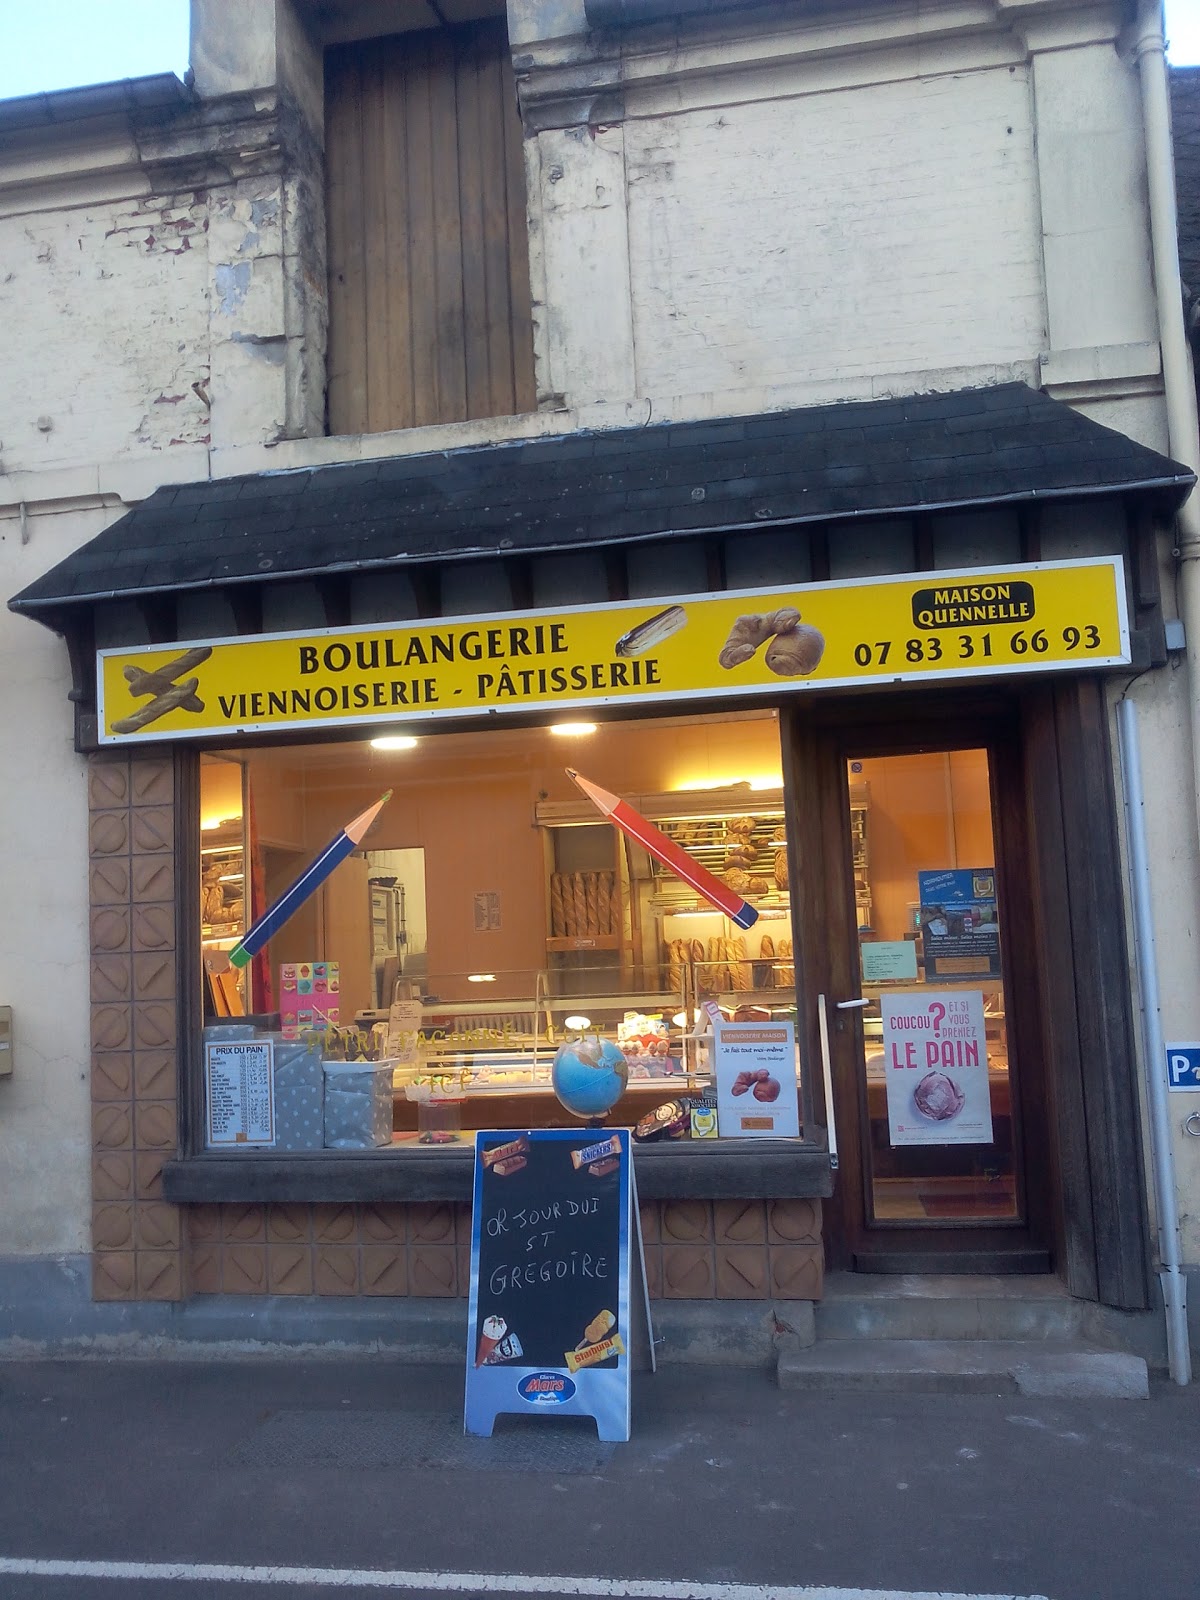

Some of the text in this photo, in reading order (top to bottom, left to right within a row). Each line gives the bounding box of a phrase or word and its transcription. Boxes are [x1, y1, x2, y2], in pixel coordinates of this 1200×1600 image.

[934, 585, 1012, 605] MAISON
[918, 602, 1031, 626] QUENNELLE
[299, 623, 569, 675] BOULANGERIE
[854, 624, 1101, 667] 07 83 31 66 93
[217, 678, 440, 719] VIENNOISERIE
[477, 659, 662, 700] PÂTISSERIE
[948, 1000, 970, 1012] ET SI
[890, 1015, 931, 1030] COUCOU
[947, 1014, 970, 1025] VOUS
[544, 1023, 606, 1045] CUIT
[942, 1026, 977, 1038] PRENIEZ
[216, 1047, 233, 1055] PRIX
[246, 1046, 263, 1054] PAIN
[892, 1040, 979, 1069] LE PAIN
[1171, 1055, 1190, 1083] P
[525, 1230, 556, 1252] ST
[574, 1338, 614, 1364] Starburst
[525, 1378, 565, 1393] Mars
